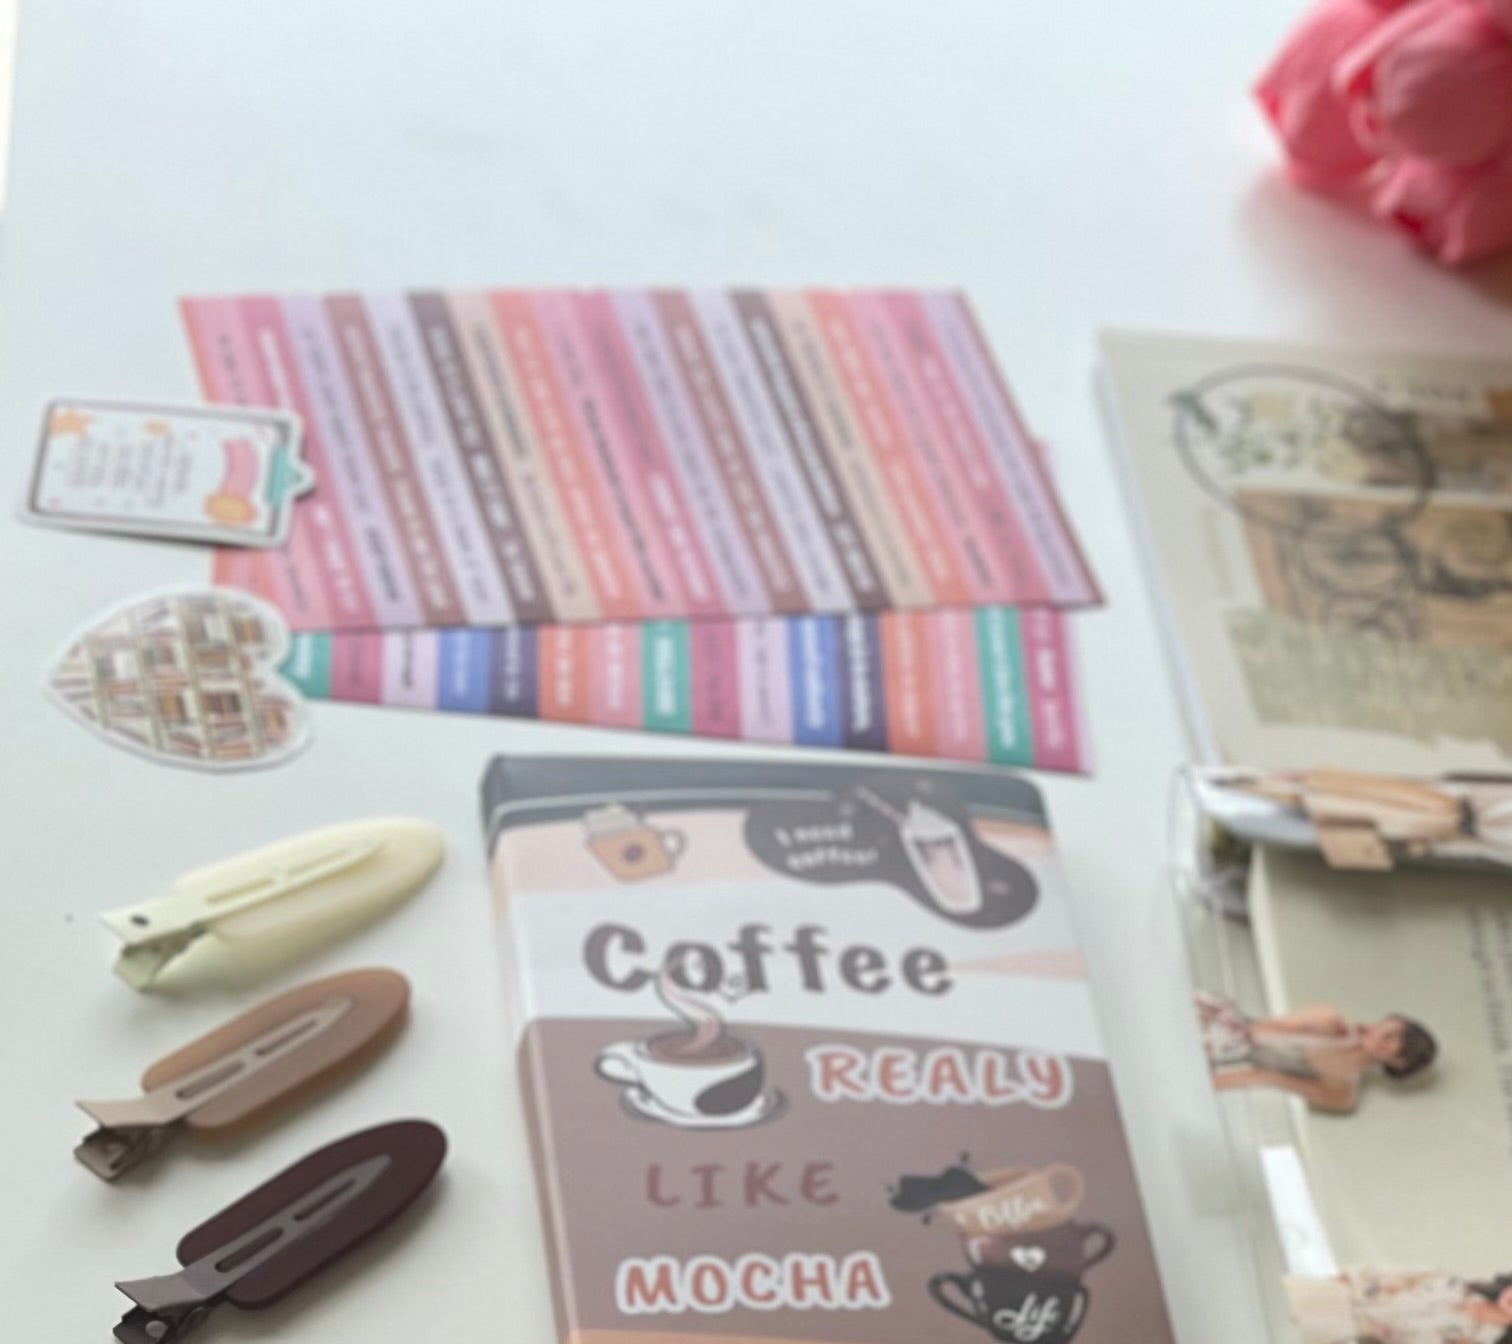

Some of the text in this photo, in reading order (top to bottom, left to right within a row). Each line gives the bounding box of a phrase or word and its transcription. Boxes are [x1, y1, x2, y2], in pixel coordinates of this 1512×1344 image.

[582, 923, 954, 996] Coffee
[810, 1049, 1071, 1105] REALY
[646, 1160, 840, 1208] LIKE
[622, 1254, 888, 1310] MOCHA
